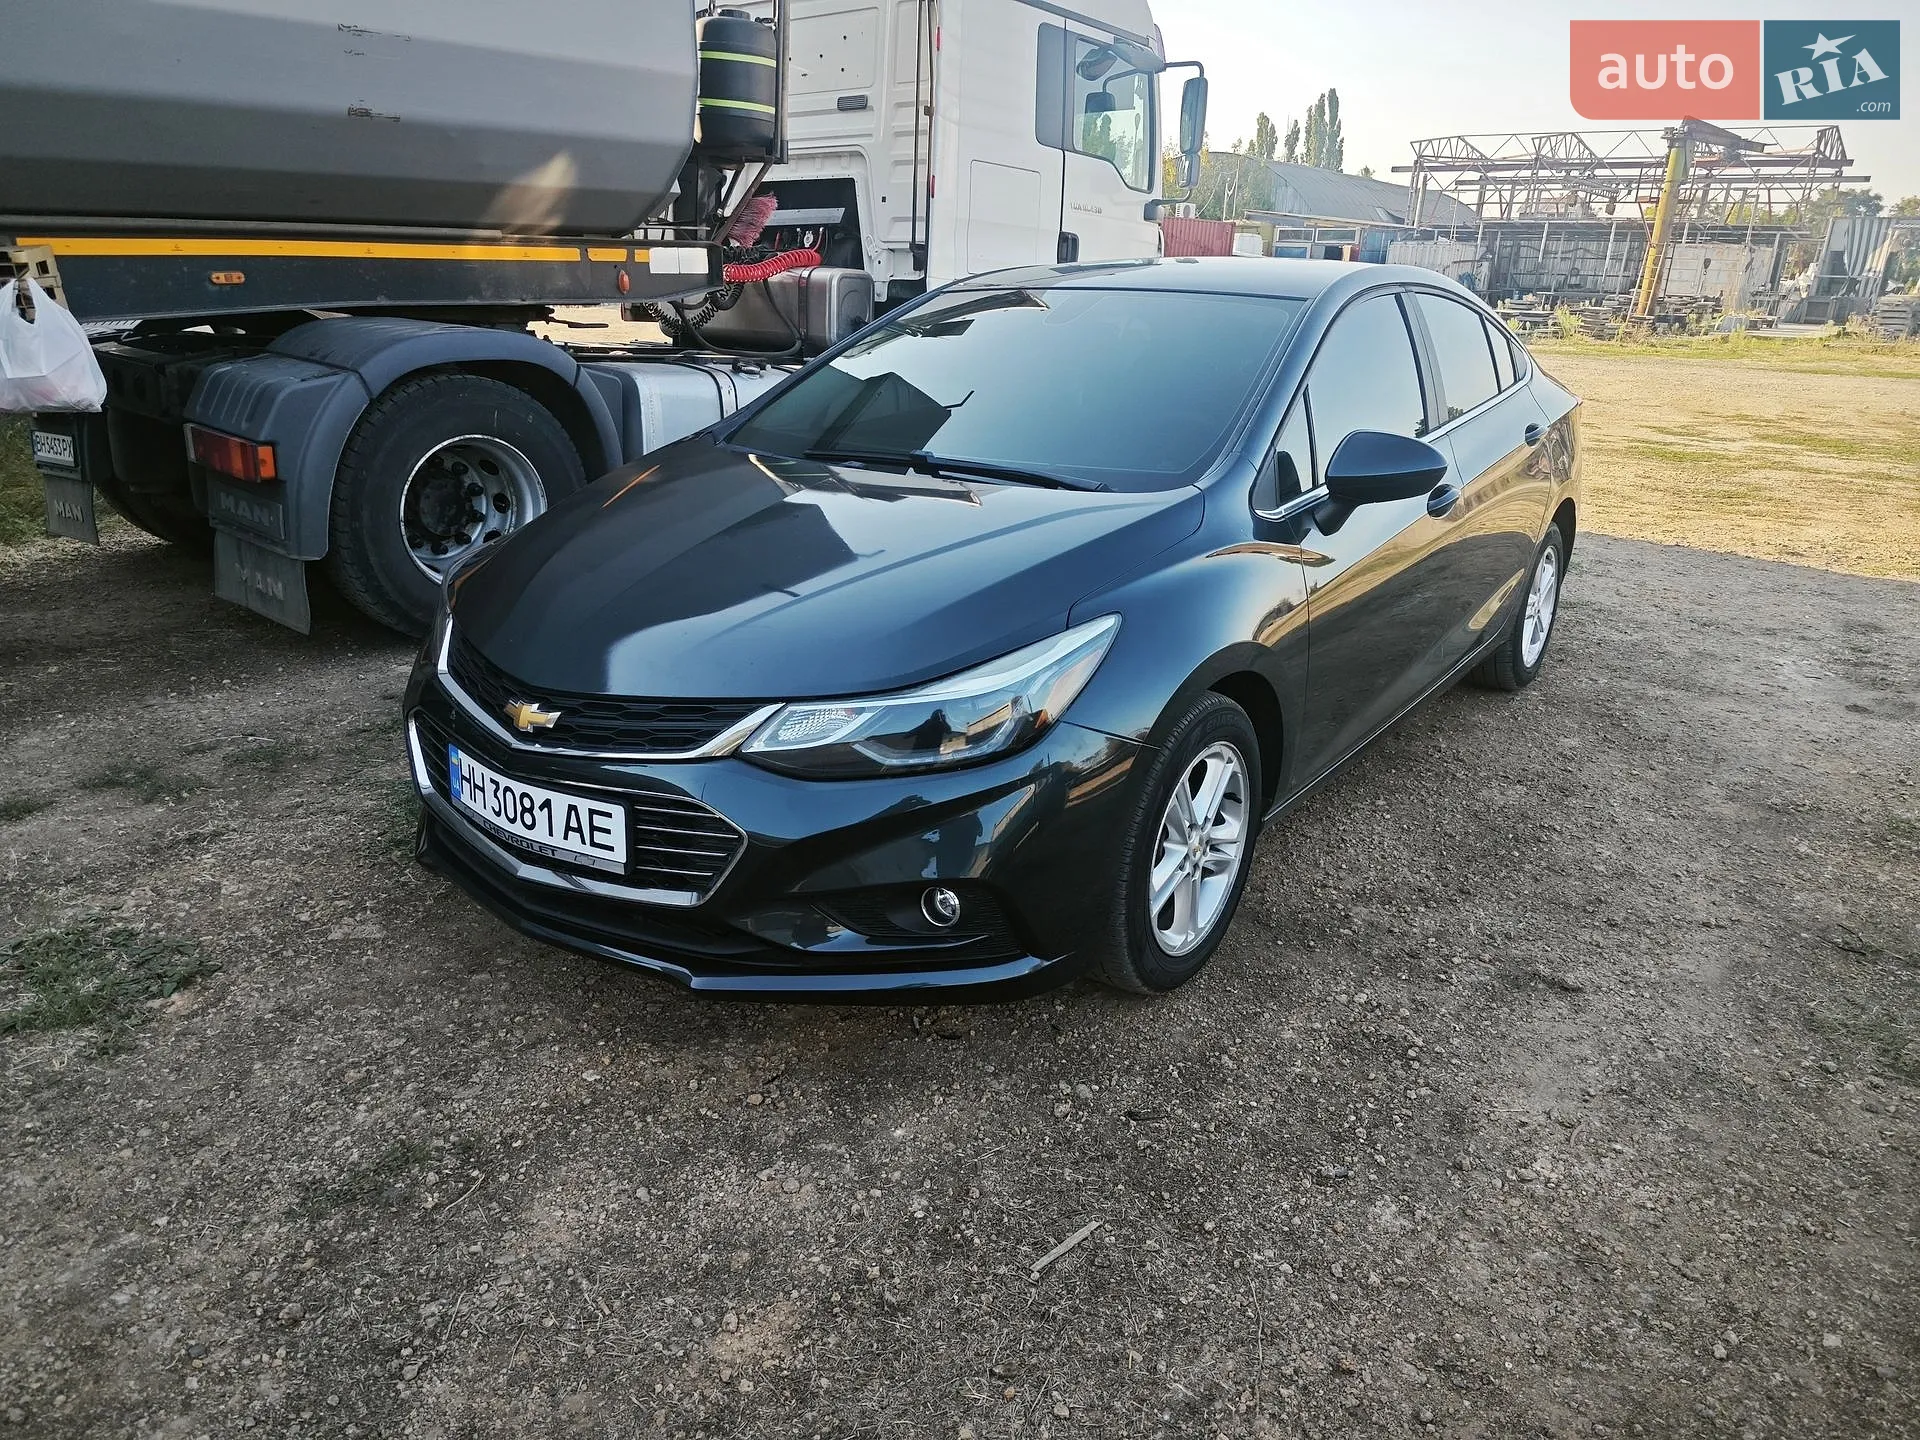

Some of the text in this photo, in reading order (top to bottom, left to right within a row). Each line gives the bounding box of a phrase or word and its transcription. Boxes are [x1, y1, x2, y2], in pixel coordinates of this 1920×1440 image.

[54, 499, 84, 523] MAN
[219, 491, 271, 527] MAN
[483, 820, 558, 857] CHEVROLET
